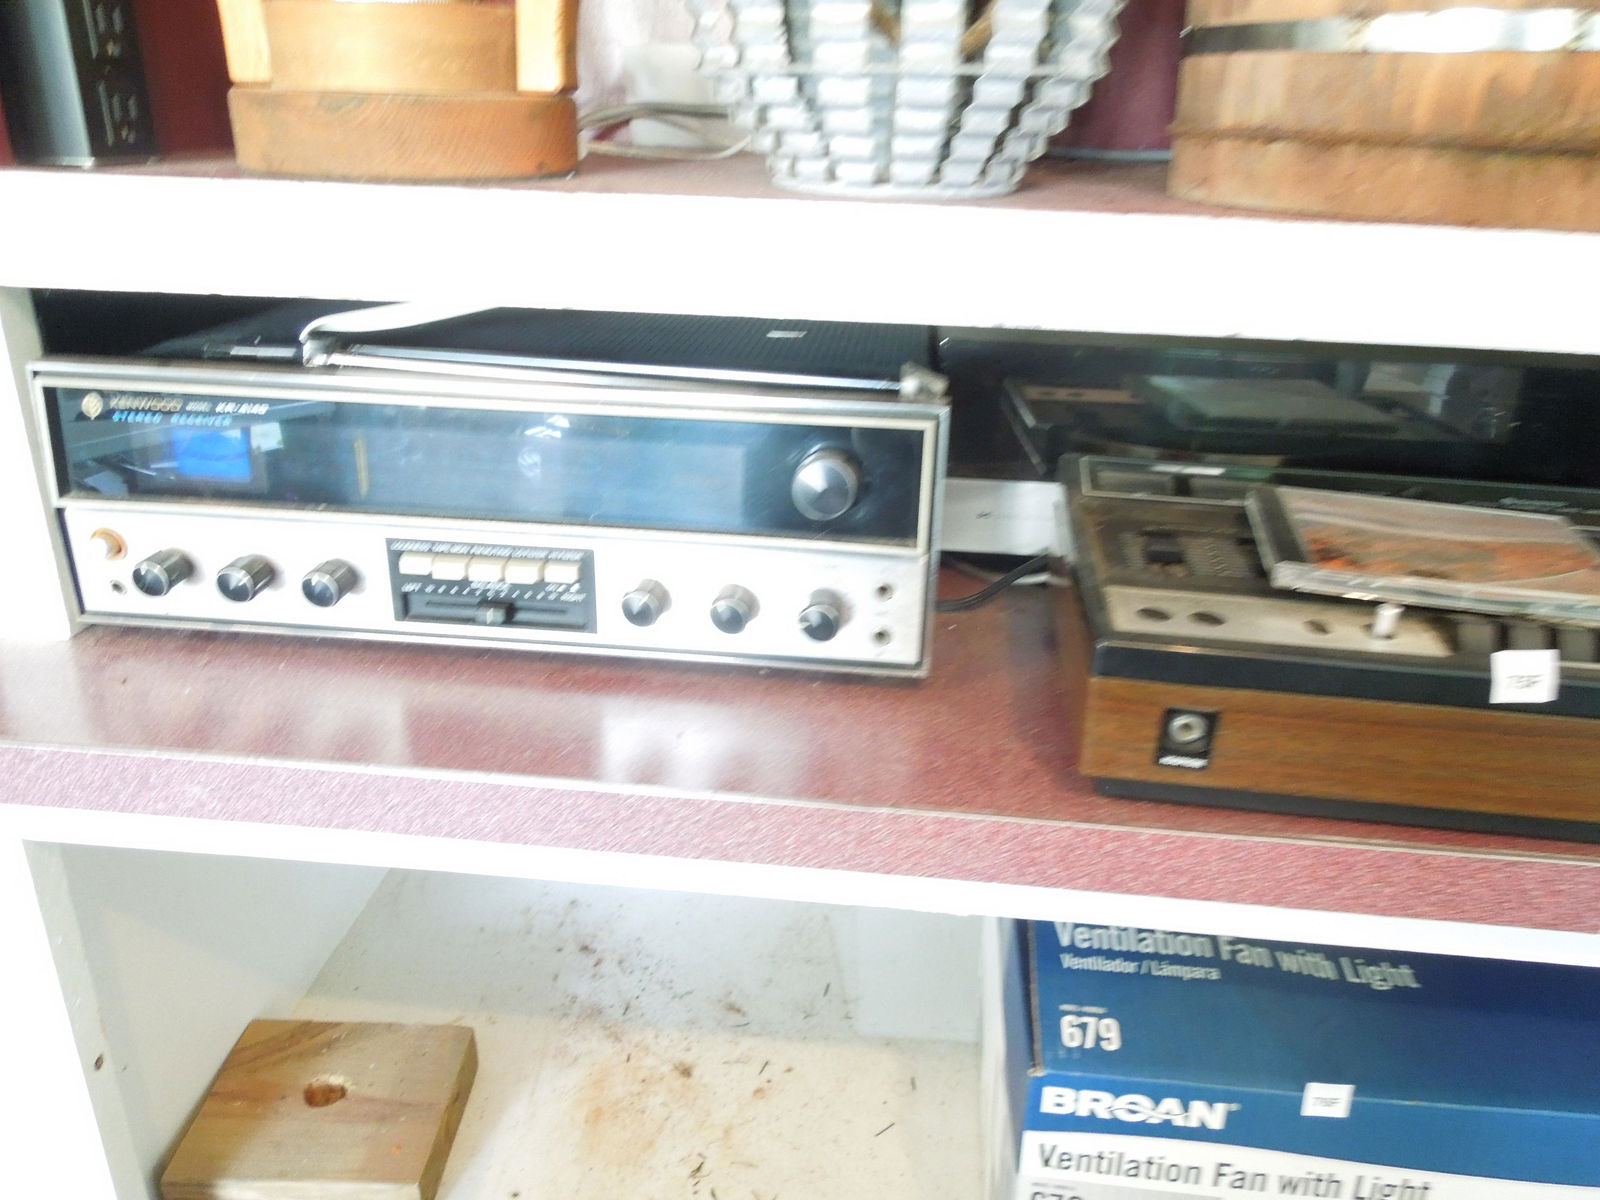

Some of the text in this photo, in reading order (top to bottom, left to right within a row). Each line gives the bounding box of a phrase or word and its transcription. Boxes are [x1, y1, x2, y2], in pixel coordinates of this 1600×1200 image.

[1053, 921, 1422, 990] Ventilation Fan with Light
[1060, 1014, 1122, 1052] 679
[1039, 1085, 1230, 1130] BROAN
[1038, 1143, 1431, 1200] Ventilation Fan with Light
